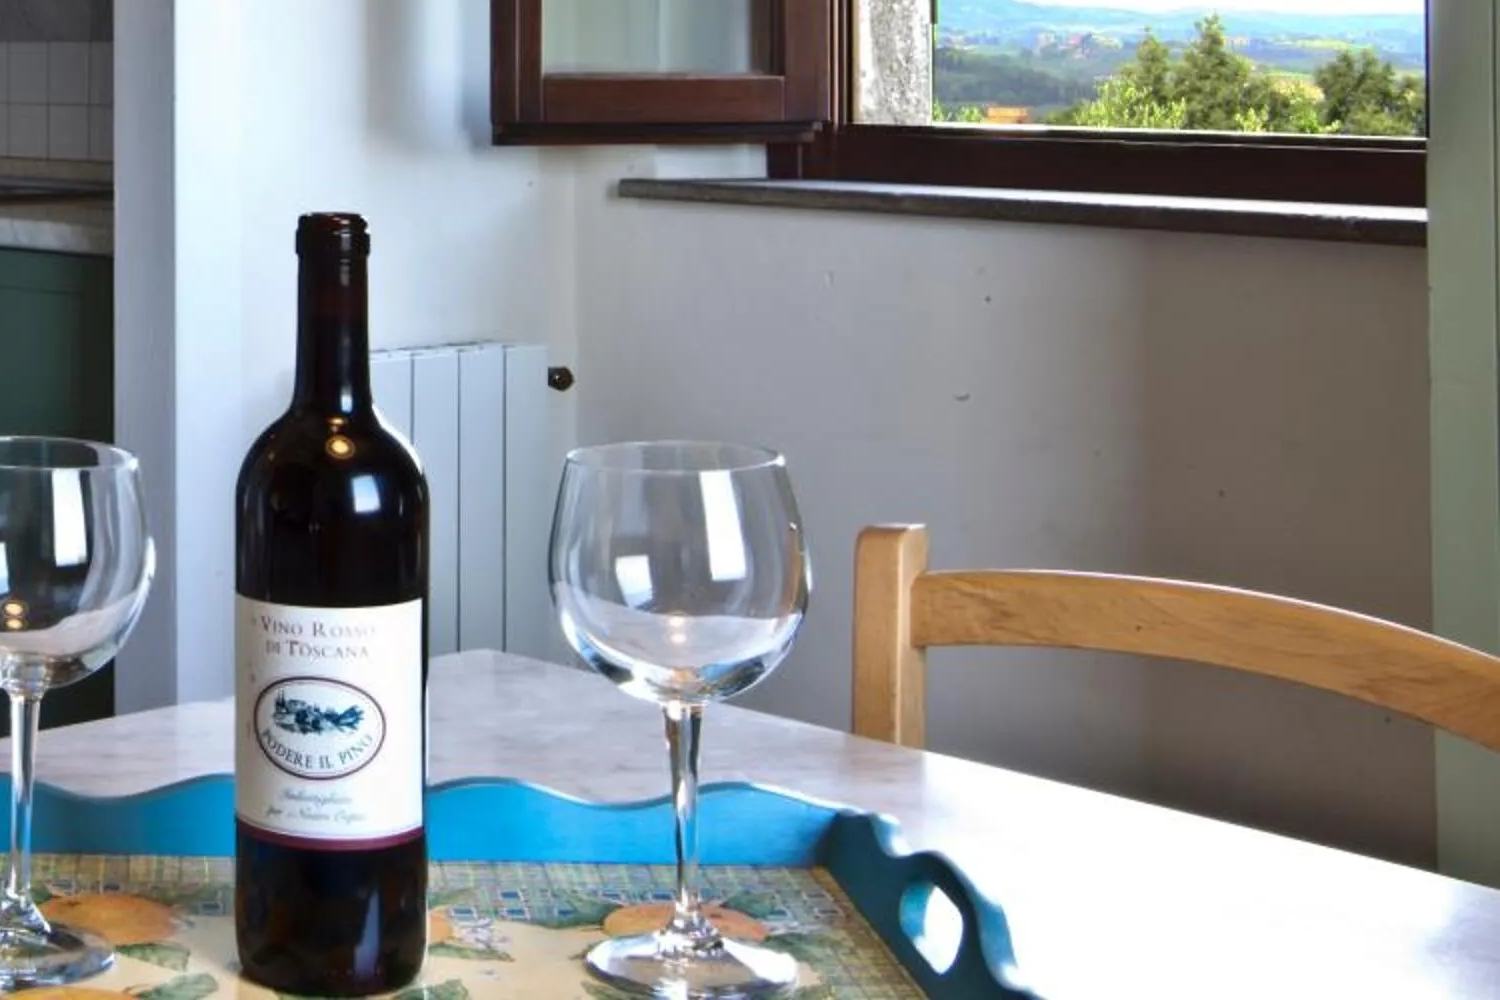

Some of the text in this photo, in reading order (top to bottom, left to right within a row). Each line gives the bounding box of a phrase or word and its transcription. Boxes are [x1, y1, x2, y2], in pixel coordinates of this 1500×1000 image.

[260, 615, 303, 636] VINO
[285, 639, 370, 659] TOSCANA
[261, 728, 373, 769] PODERE IL PINO
